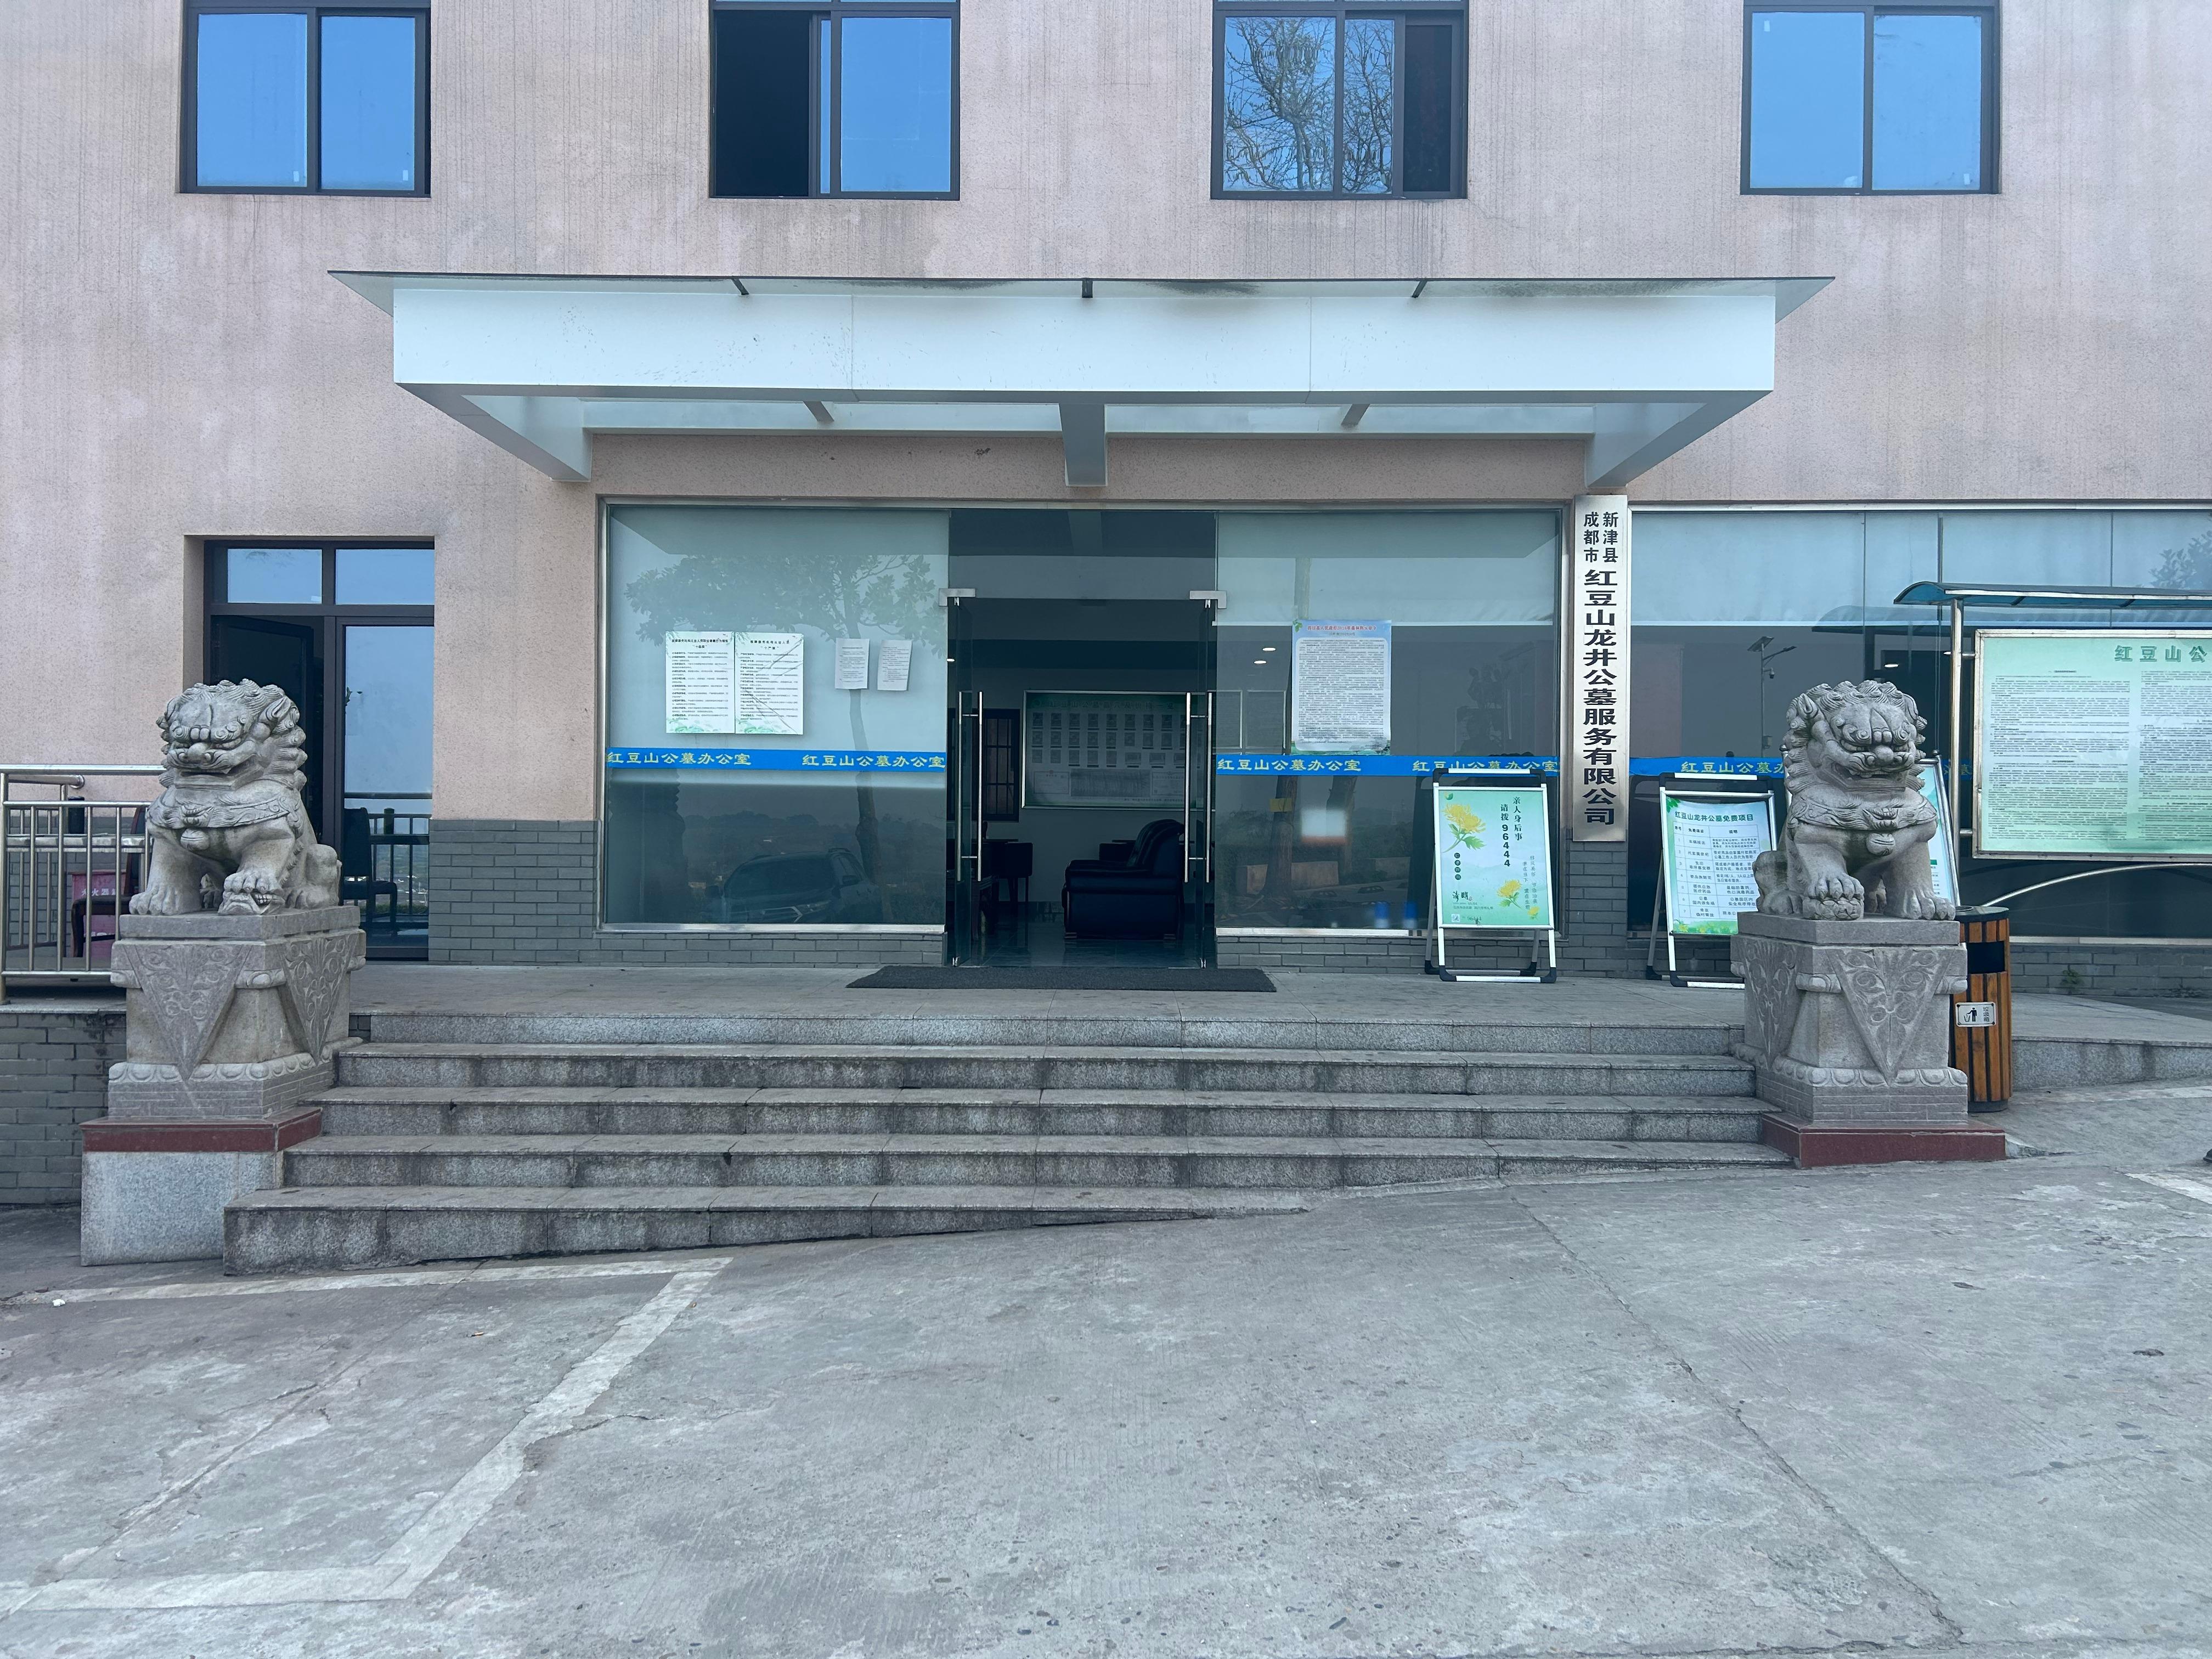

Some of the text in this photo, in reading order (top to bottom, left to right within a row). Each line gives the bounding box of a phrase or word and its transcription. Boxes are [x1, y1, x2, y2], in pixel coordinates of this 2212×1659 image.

[1583, 511, 1599, 562] 成都市
[1602, 511, 1618, 562] 新津县
[2114, 645, 2208, 663] 红豆山公
[1582, 569, 1618, 826] 红豆山龙井公墓服务有限公司
[607, 752, 752, 765] 红豆山公墓办公室
[802, 755, 946, 768] 红豆山公墓办公室
[1217, 759, 1362, 772] 红豆山公墓办公室
[1513, 796, 1522, 841] 亲人身后事
[1675, 811, 1753, 822] 红豆山龙井公墓免费项目
